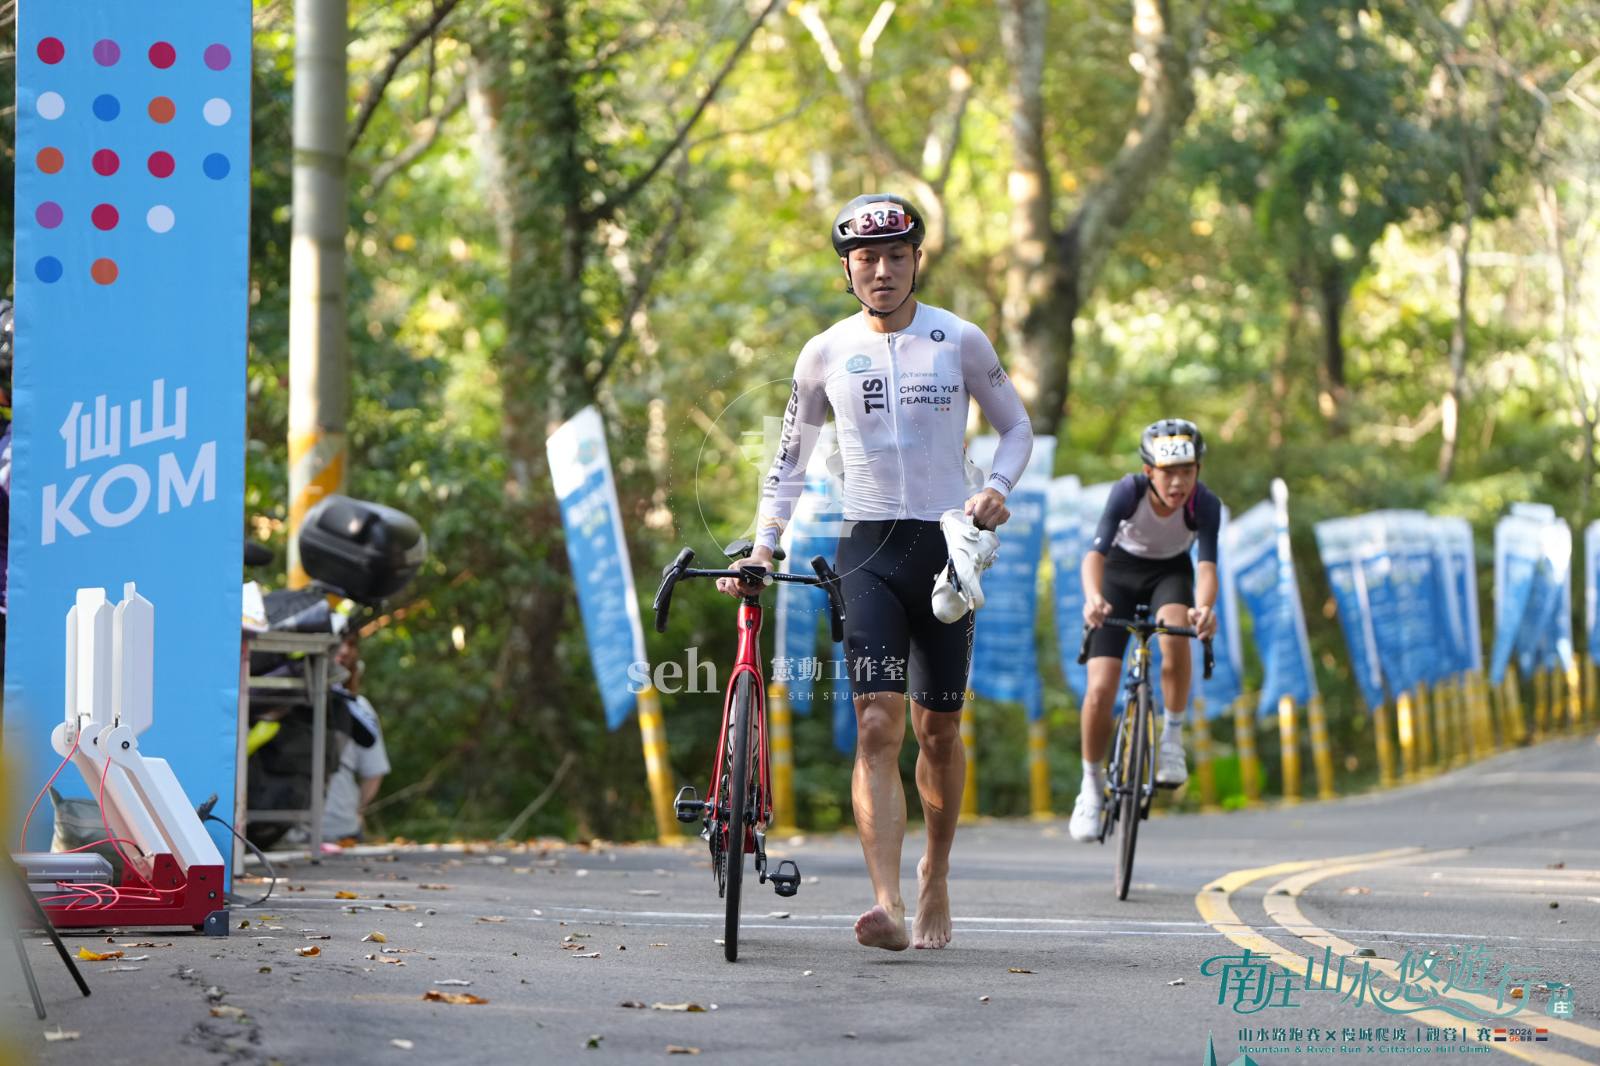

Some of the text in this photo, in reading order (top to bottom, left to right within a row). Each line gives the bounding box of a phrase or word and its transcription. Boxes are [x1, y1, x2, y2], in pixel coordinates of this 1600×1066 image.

[860, 209, 900, 230] 335
[862, 378, 885, 414] TIS
[899, 384, 960, 394] CHONG YUE
[900, 396, 952, 406] FEARLESS
[58, 377, 188, 471] 仙山
[1160, 442, 1188, 457] 521
[41, 440, 217, 546] KOM
